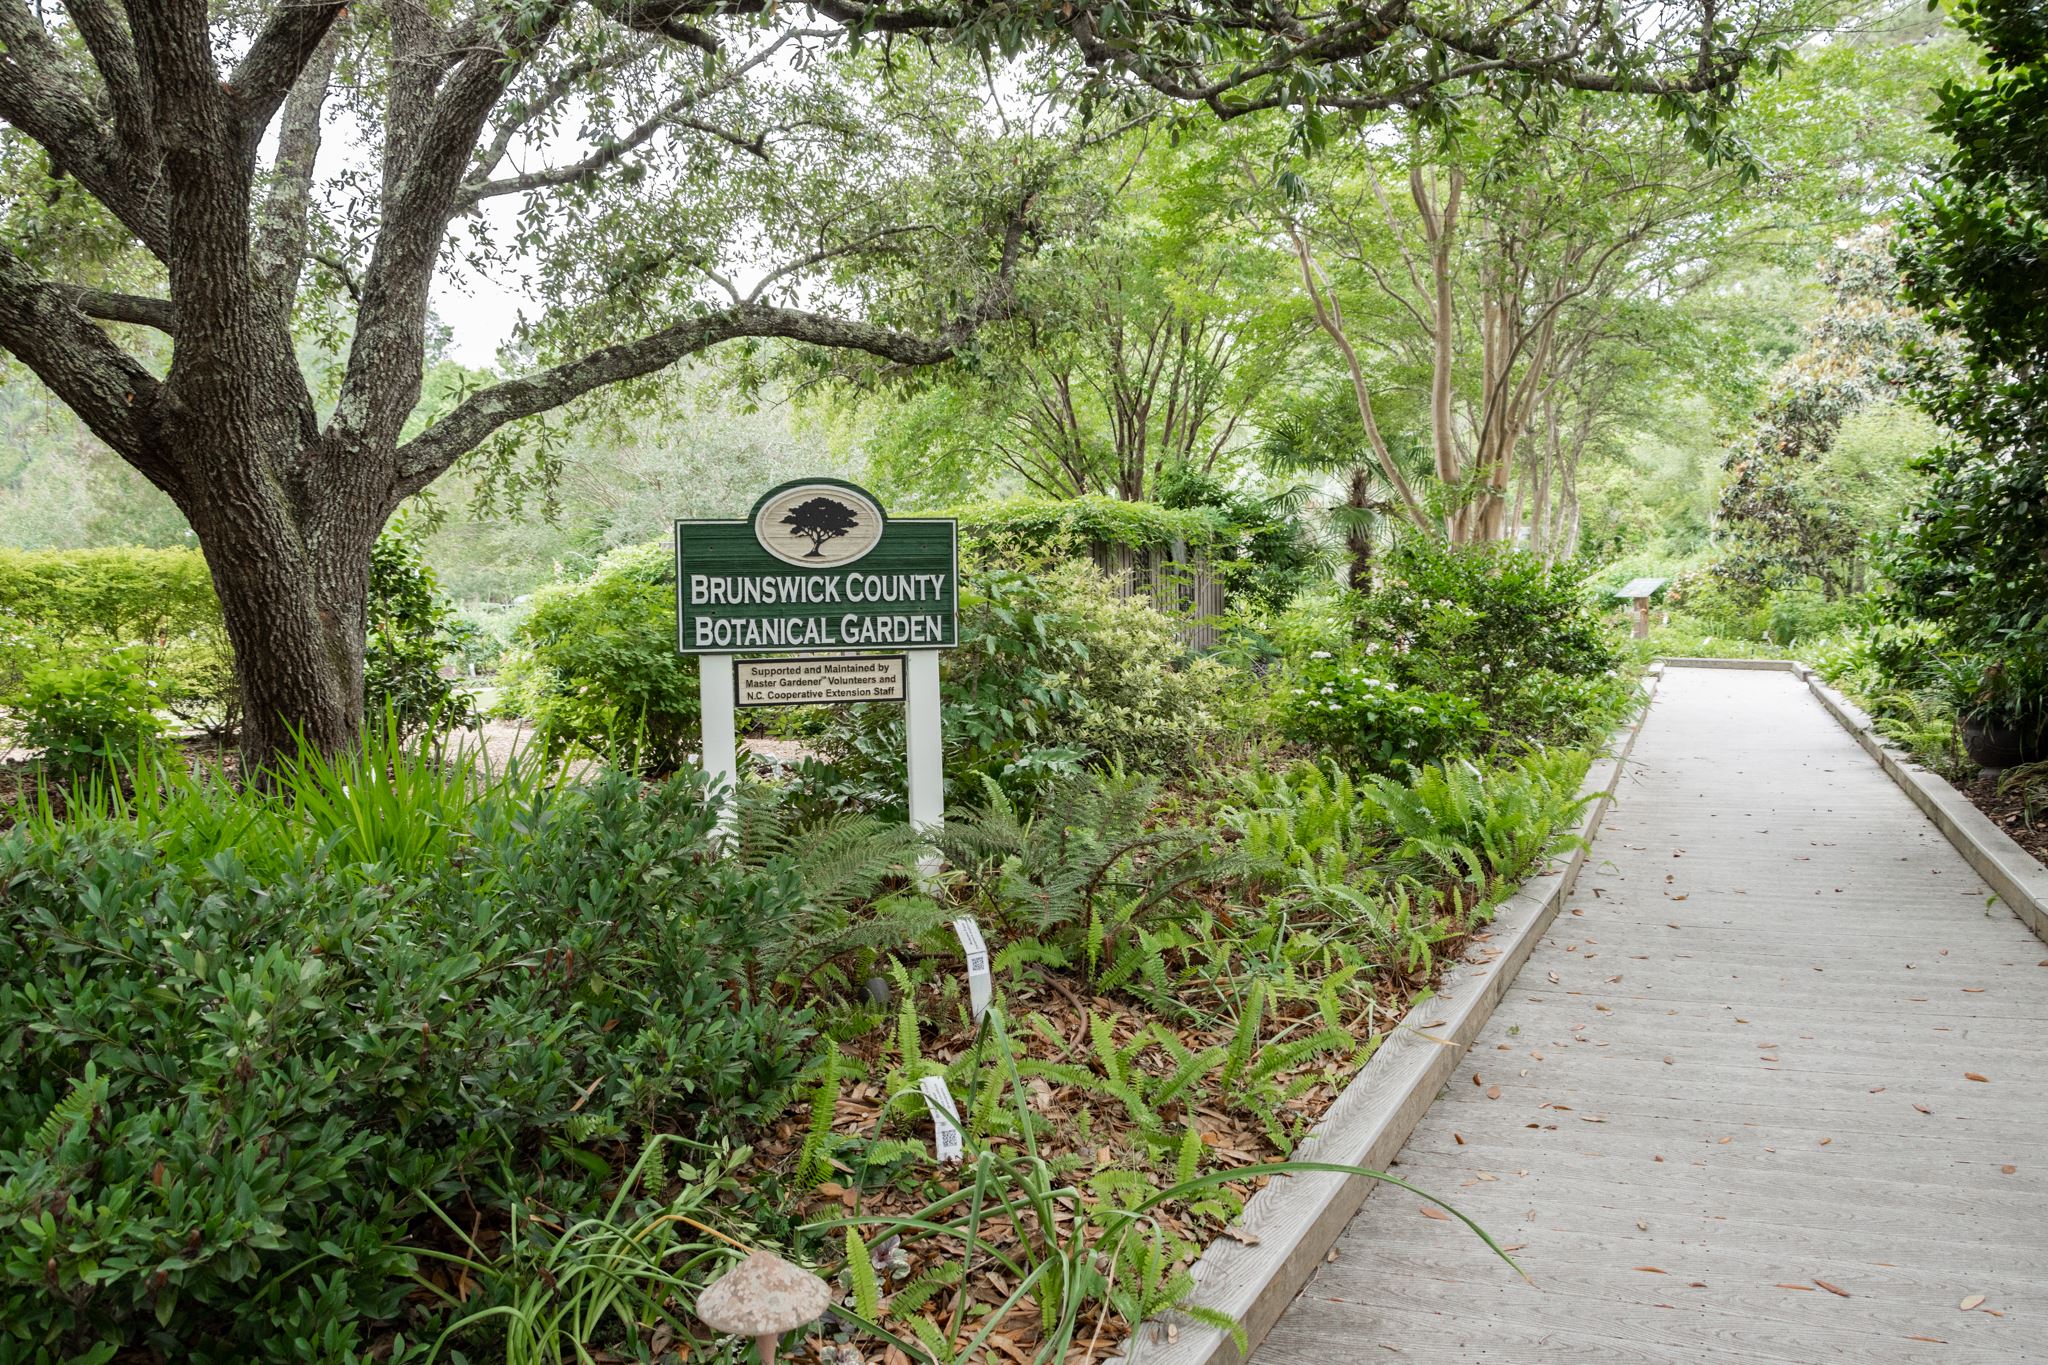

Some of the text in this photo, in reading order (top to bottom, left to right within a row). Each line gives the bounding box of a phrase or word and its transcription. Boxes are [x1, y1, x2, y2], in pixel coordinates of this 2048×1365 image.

[691, 572, 946, 605] BRUNSWICK COUNTY
[695, 613, 943, 646] BOTANICAL GARDEN
[751, 663, 890, 677] Supported and Maintained by
[745, 679, 777, 689] Master
[828, 676, 877, 685] Volunteers
[879, 674, 896, 683] and
[747, 686, 895, 701] N.C. Cooperative Extension Staff
